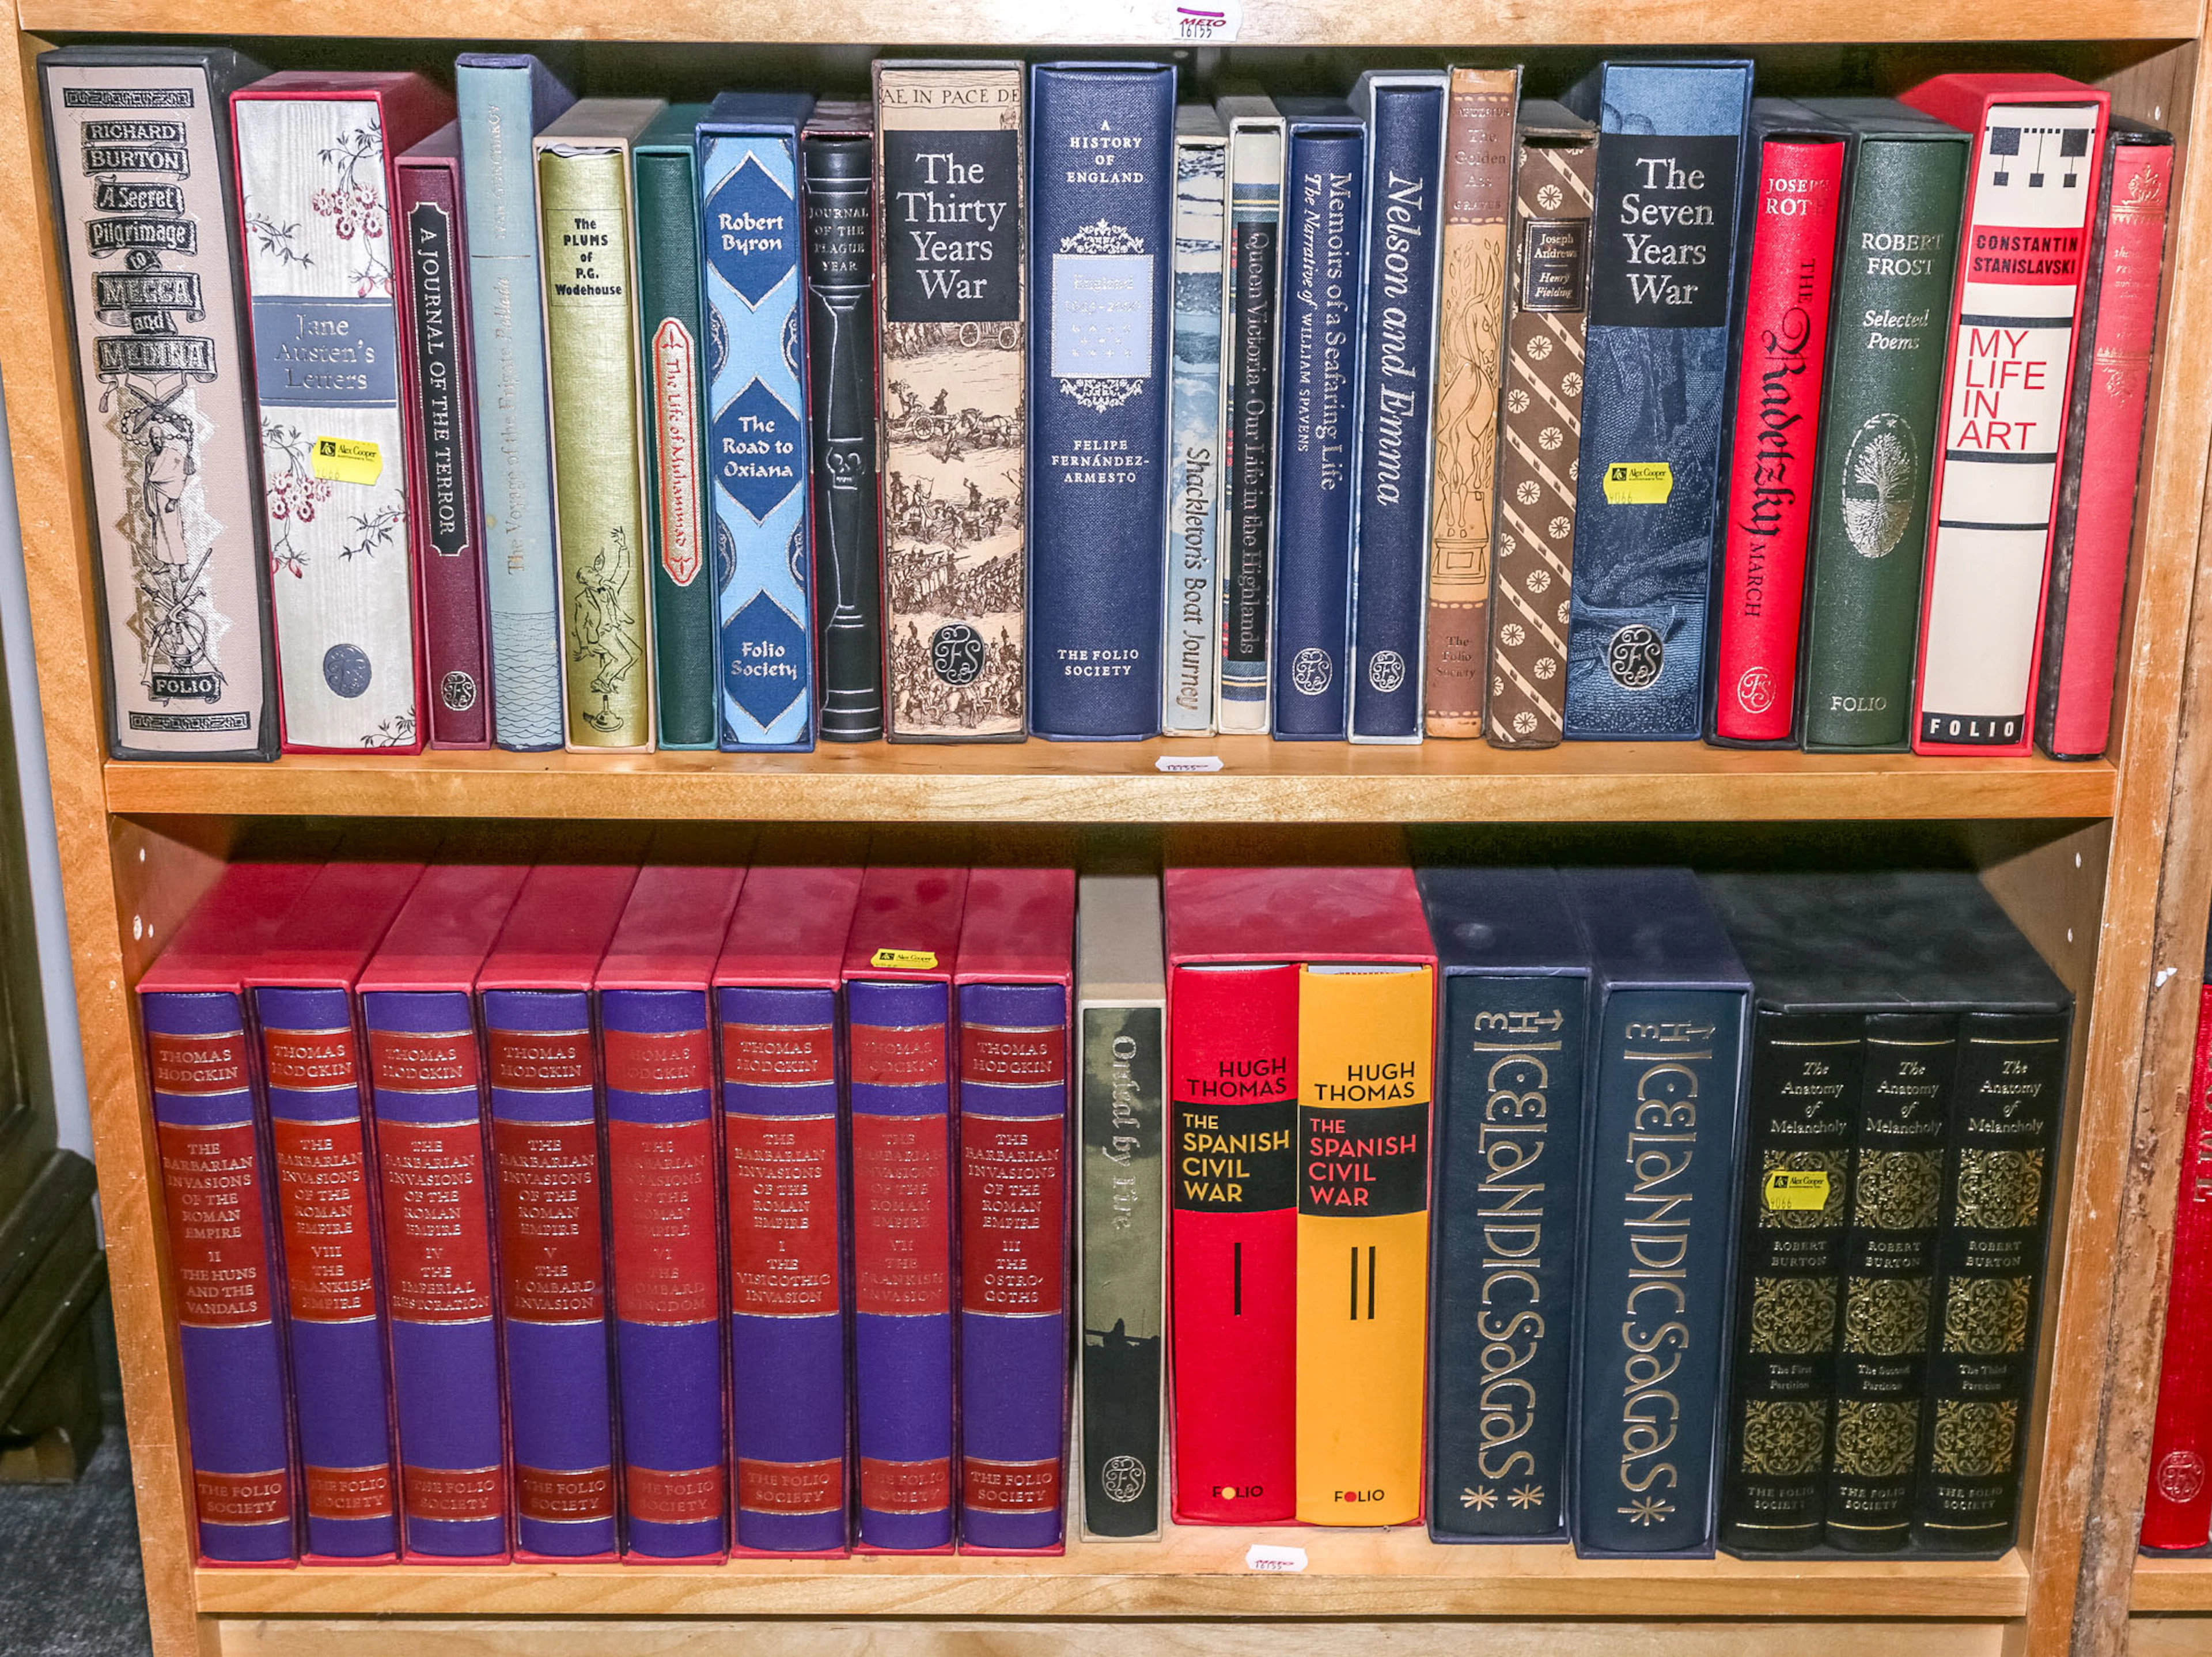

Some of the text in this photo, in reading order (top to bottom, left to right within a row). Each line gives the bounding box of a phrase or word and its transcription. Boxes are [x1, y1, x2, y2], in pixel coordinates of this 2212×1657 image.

[1180, 18, 1226, 27] METO
[914, 89, 988, 103] IN PACE
[91, 124, 175, 139] RICHARD
[1101, 120, 1110, 130] A
[1070, 138, 1142, 148] HISTORY
[91, 149, 179, 168] BURTON
[1095, 155, 1115, 165] OF
[915, 153, 984, 184] The
[1636, 158, 1704, 190] The
[1067, 172, 1144, 183] ENGLAND
[103, 187, 174, 209] A Secret
[809, 207, 869, 219] JOURNAL
[896, 192, 1006, 231] Thirty
[1621, 194, 1715, 226] Seven
[575, 217, 597, 229] The
[719, 213, 783, 231] Robert
[815, 225, 865, 236] OF THE
[93, 223, 186, 250] Pilgrimage
[563, 234, 609, 246] PLUMS
[1540, 233, 1574, 245] Joseph
[1862, 233, 1944, 251] ROBERT
[1976, 234, 2078, 252] CONSTANTIN
[722, 235, 782, 256] Byron
[815, 243, 865, 254] PLAGUE
[910, 232, 993, 261] Years
[1533, 249, 1577, 259] Andrews
[1623, 233, 1706, 265] Years
[130, 252, 147, 268] to
[581, 251, 592, 263] of
[575, 268, 599, 279] P.G.
[823, 262, 857, 271] YEAR
[1867, 258, 1932, 275] FROST
[1973, 258, 2076, 274] STANISLAVSKI
[916, 270, 987, 300] War
[1539, 273, 1570, 284] Henry
[100, 279, 190, 305] MECCA
[555, 284, 622, 295] Wodehouse
[1535, 287, 1573, 298] Fielding
[1626, 273, 1698, 305] War
[1297, 174, 1321, 452] The Narrative of WILLIAM SPAVENS
[1863, 309, 1930, 328] Selected
[134, 314, 165, 331] and
[295, 315, 349, 340] Jane
[1316, 173, 1351, 490] Memoirs of a Seafaring Life
[1377, 171, 1423, 506] Nelson and Emma
[1868, 332, 1921, 350] Poems
[1969, 328, 2029, 359] MY
[101, 345, 204, 369] MEDINA
[274, 339, 375, 363] Austen's
[284, 368, 368, 390] Letters
[418, 228, 454, 535] A JOURNAL OF THE TERROR
[1965, 361, 2047, 390] LIFE
[1963, 391, 1999, 419] IN
[738, 416, 775, 433] The
[1240, 232, 1270, 654] Queen Victoria Our Life in the Highlands
[1738, 259, 1815, 617] THE Radetzky MARCH
[1957, 421, 2036, 451] ART
[338, 445, 377, 457] Alex Cooper
[665, 358, 687, 547] The Life of Muhammad
[722, 437, 794, 455] Road to
[1074, 440, 1128, 451] FELIPE
[1052, 454, 1149, 466] FERNÁNDEZ-
[724, 461, 793, 478] Oxiana
[1064, 472, 1135, 483] ARMESTO
[1176, 448, 1210, 710] Shackleton's Boat Journey
[742, 640, 785, 658] Folio
[1058, 649, 1138, 660] THE FOLIO
[731, 660, 797, 680] Society
[1065, 665, 1131, 676] SOCIETY
[156, 679, 211, 693] FOLIO
[1831, 696, 1887, 712] FOLIO
[1930, 718, 2014, 737] FOLIO
[160, 1049, 232, 1063] THOMAS
[158, 1067, 238, 1082] HODGKIN
[1219, 1057, 1286, 1077] HUGH
[1348, 1061, 1415, 1081] HUGH
[1802, 1062, 1829, 1075] The
[1187, 1078, 1287, 1098] THOMAS
[1315, 1082, 1415, 1101] THOMAS
[1781, 1081, 1844, 1097] Anatomy
[1806, 1101, 1823, 1117] of
[1183, 1113, 1218, 1129] THE
[1310, 1119, 1346, 1133] THE
[1771, 1119, 1846, 1134] Melancholy
[1103, 1036, 1141, 1230] Ordeal by Fire
[1183, 1130, 1290, 1153] SPANISH
[187, 1143, 220, 1155] THE
[1310, 1134, 1416, 1156] SPANISH
[162, 1156, 252, 1172] BARBARIAN
[1183, 1157, 1250, 1178] CIVIL
[1309, 1163, 1376, 1182] CIVIL
[168, 1174, 251, 1188] INVASIONS
[181, 1193, 238, 1205] OF THE
[1184, 1181, 1243, 1202] WAR
[1310, 1185, 1369, 1206] WAR
[182, 1210, 241, 1223] ROMAN
[185, 1227, 241, 1239] EMPIRE
[1774, 1241, 1826, 1251] ROBERT
[209, 1251, 221, 1262] II
[1771, 1257, 1827, 1266] BURTON
[183, 1268, 256, 1280] THE HUNS
[1234, 1242, 1241, 1316] I
[187, 1285, 253, 1297] AND THE
[1350, 1246, 1376, 1321] II
[186, 1302, 257, 1314] VANDALS
